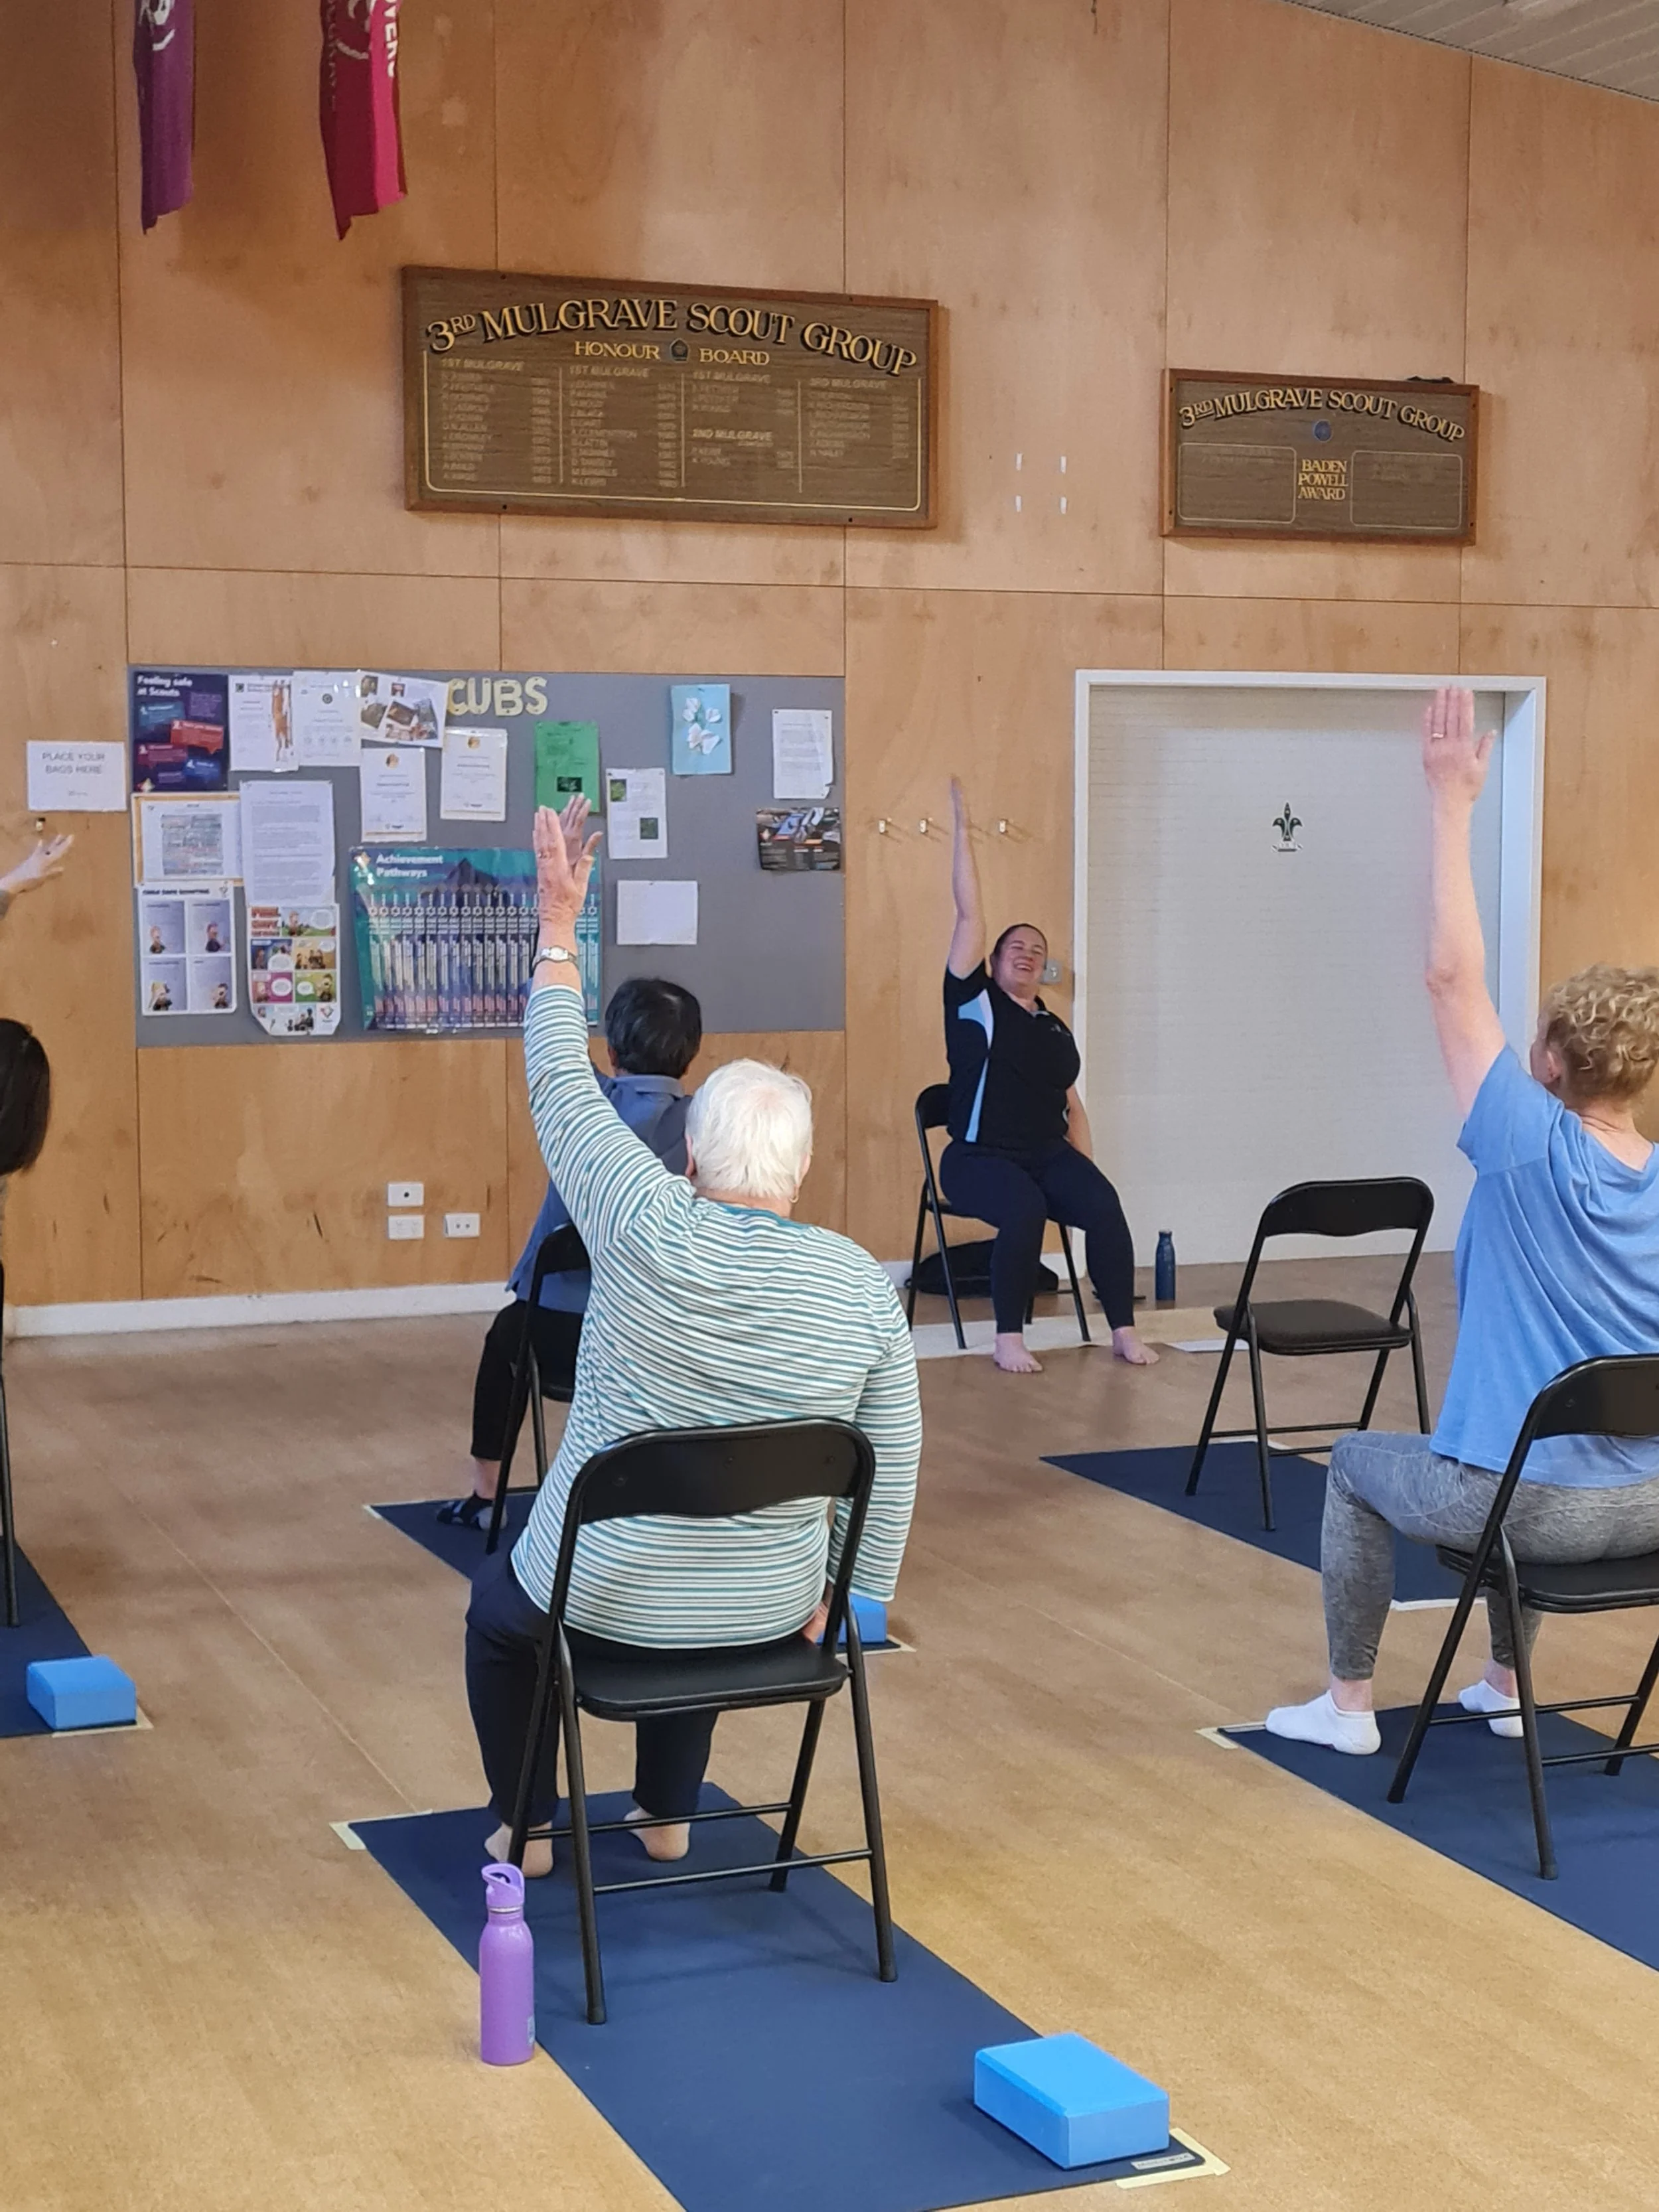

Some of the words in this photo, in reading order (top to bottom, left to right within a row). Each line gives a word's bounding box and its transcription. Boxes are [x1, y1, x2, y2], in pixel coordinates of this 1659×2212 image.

[427, 314, 476, 352] 3RD
[480, 298, 679, 342] MULGRAVE
[688, 302, 795, 344] SCOUT
[802, 322, 918, 376] GROUP
[574, 340, 661, 360] HONOUR
[699, 347, 770, 366] BOARD
[1179, 400, 1214, 427] 3RD
[1213, 388, 1323, 419] MULGRAVE
[1327, 390, 1398, 419] SCOUT
[1399, 405, 1465, 441] GROUP
[1301, 459, 1347, 473] BADEN
[1298, 472, 1349, 487] POWELL
[1297, 486, 1346, 500] AWARD
[137, 674, 171, 688] Feeling
[173, 676, 193, 687] safe
[136, 687, 147, 696] at
[149, 686, 180, 697] Scouts
[447, 676, 548, 716] CUBS
[376, 853, 444, 864] Achievement
[376, 867, 428, 880] Pathways
